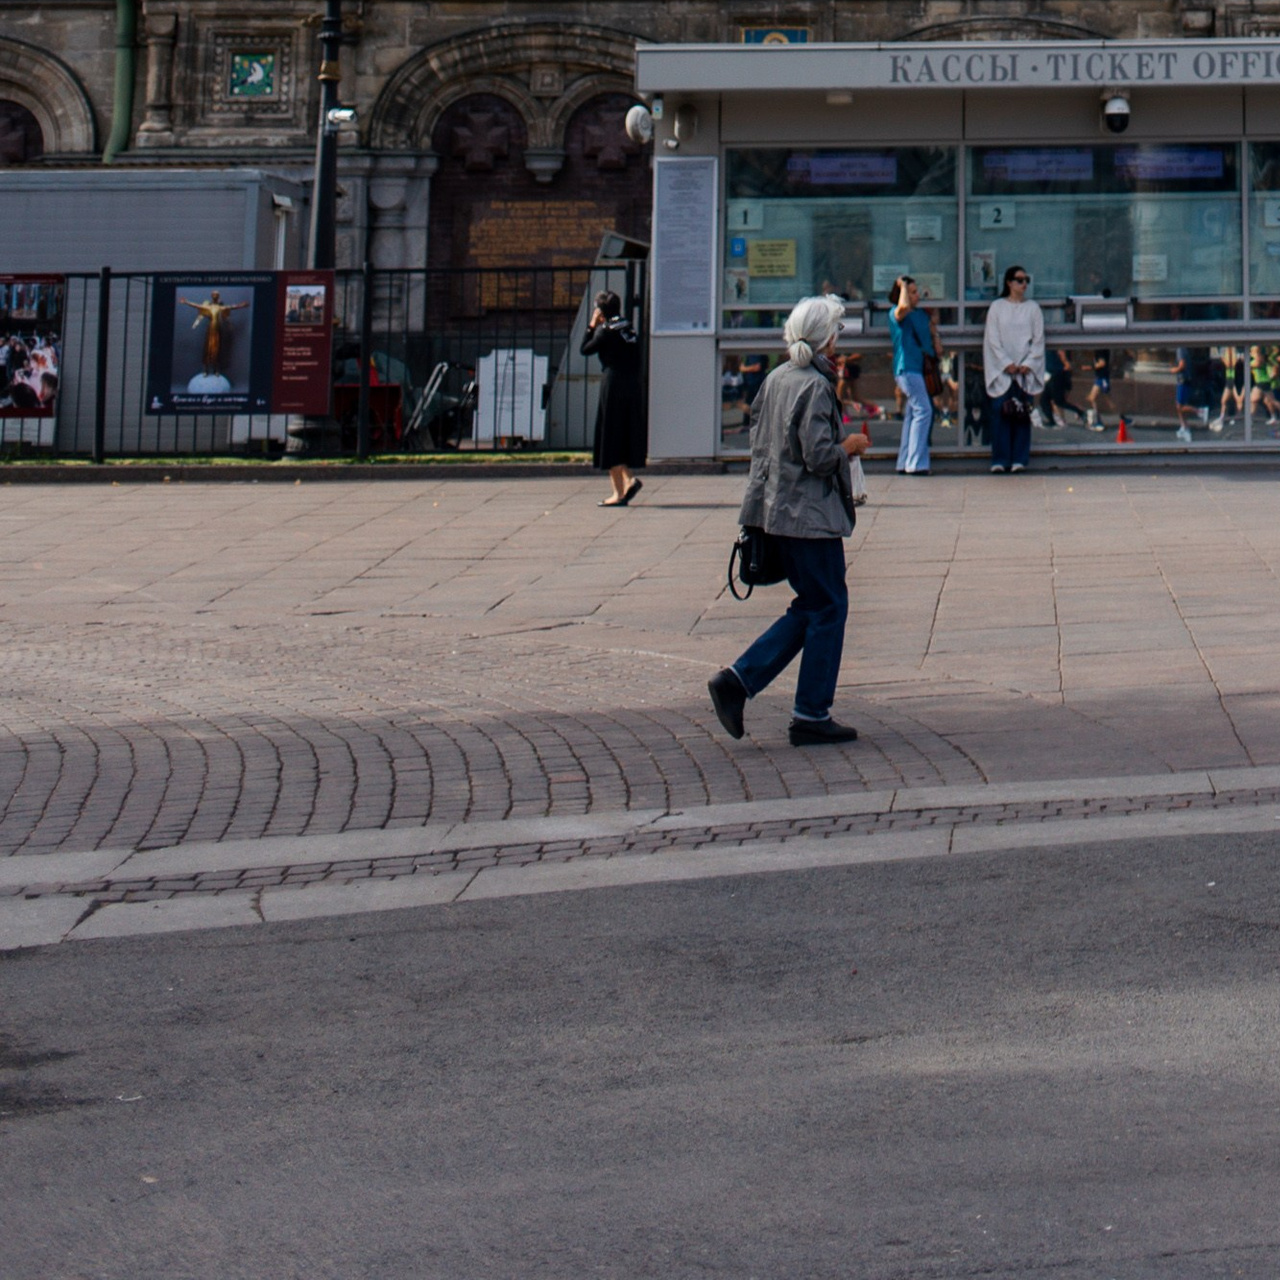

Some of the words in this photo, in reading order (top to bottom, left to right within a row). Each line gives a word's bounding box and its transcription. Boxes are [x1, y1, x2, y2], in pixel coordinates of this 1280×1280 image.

[889, 54, 1020, 83] КАССЫ
[1047, 52, 1178, 81] TICKET
[993, 207, 1003, 224] 2
